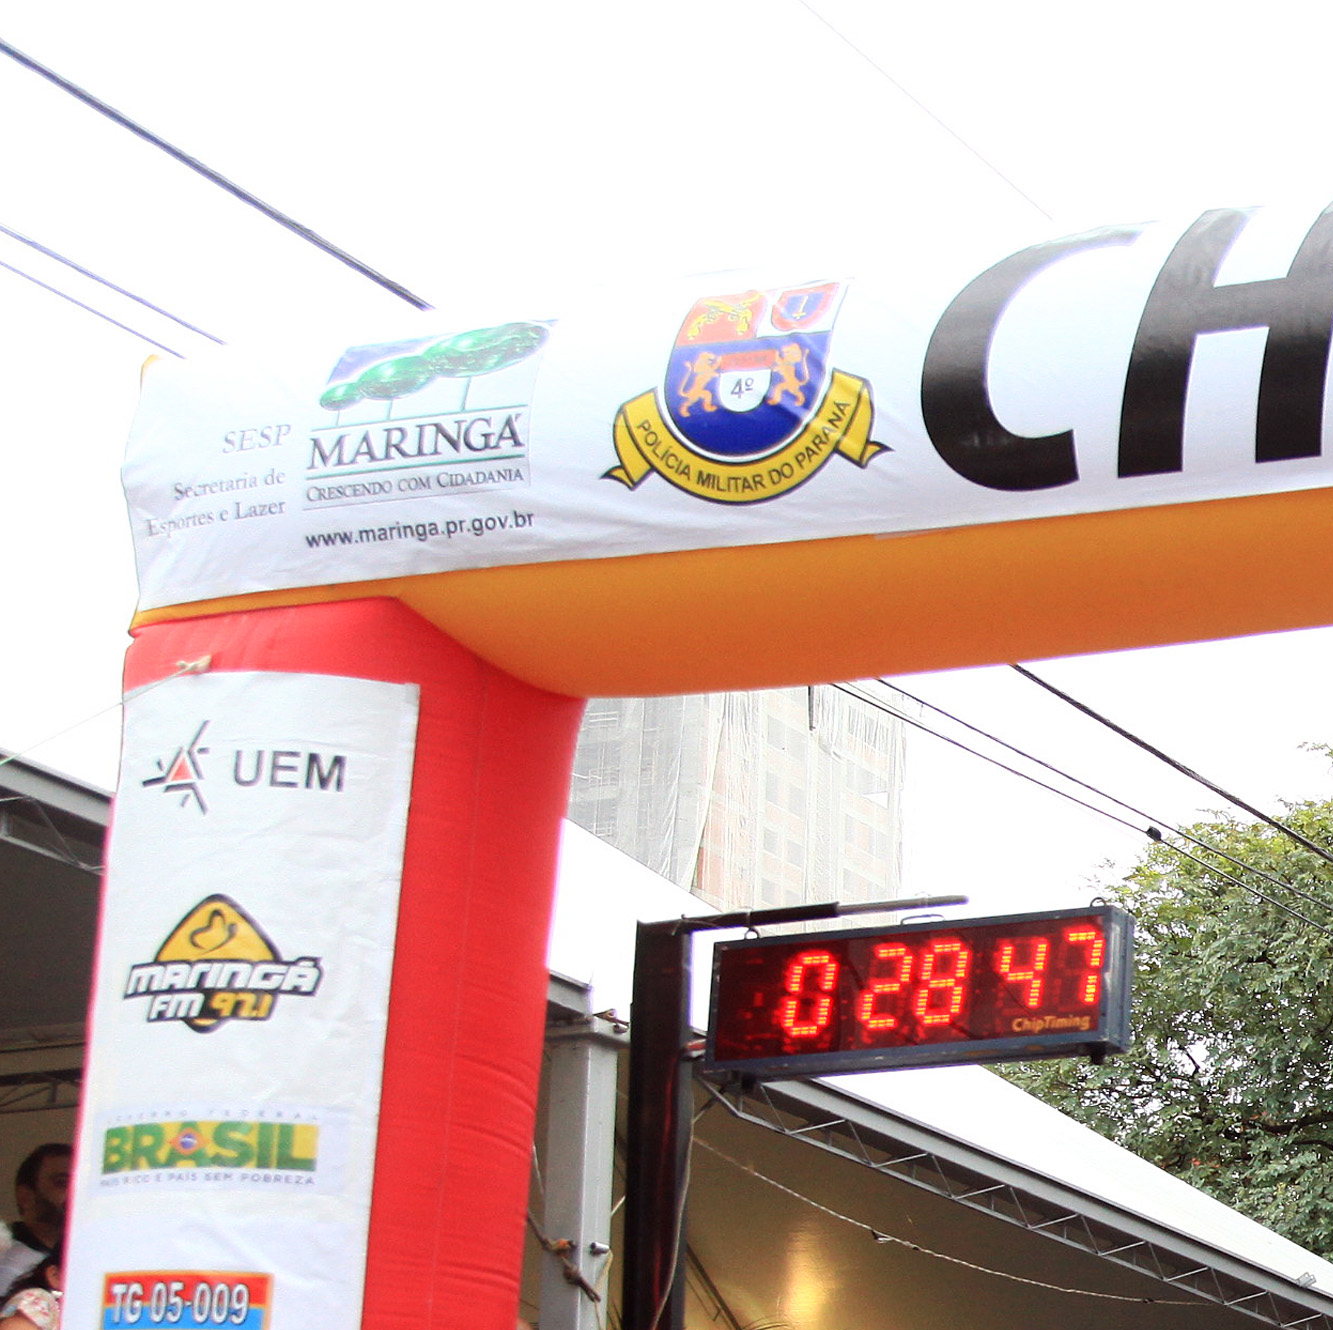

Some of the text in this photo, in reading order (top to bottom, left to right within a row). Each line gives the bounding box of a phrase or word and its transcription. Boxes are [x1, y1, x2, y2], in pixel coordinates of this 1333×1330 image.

[223, 423, 292, 455] SESP
[306, 412, 524, 470] MARINGÁ
[174, 467, 286, 502] Secretaria de
[698, 468, 768, 494] MILITAR
[771, 461, 797, 487] DO
[146, 499, 286, 539] Esportes e Lazer
[306, 511, 535, 549] www.maringa.pr.gov.br
[232, 750, 347, 793] UEM
[1011, 1013, 1093, 1033] ChipTiming
[102, 1121, 319, 1175] BRASIL
[204, 1171, 234, 1183] SEM
[241, 1172, 317, 1186] POBREZA
[110, 1281, 250, 1326] TG 05-009
